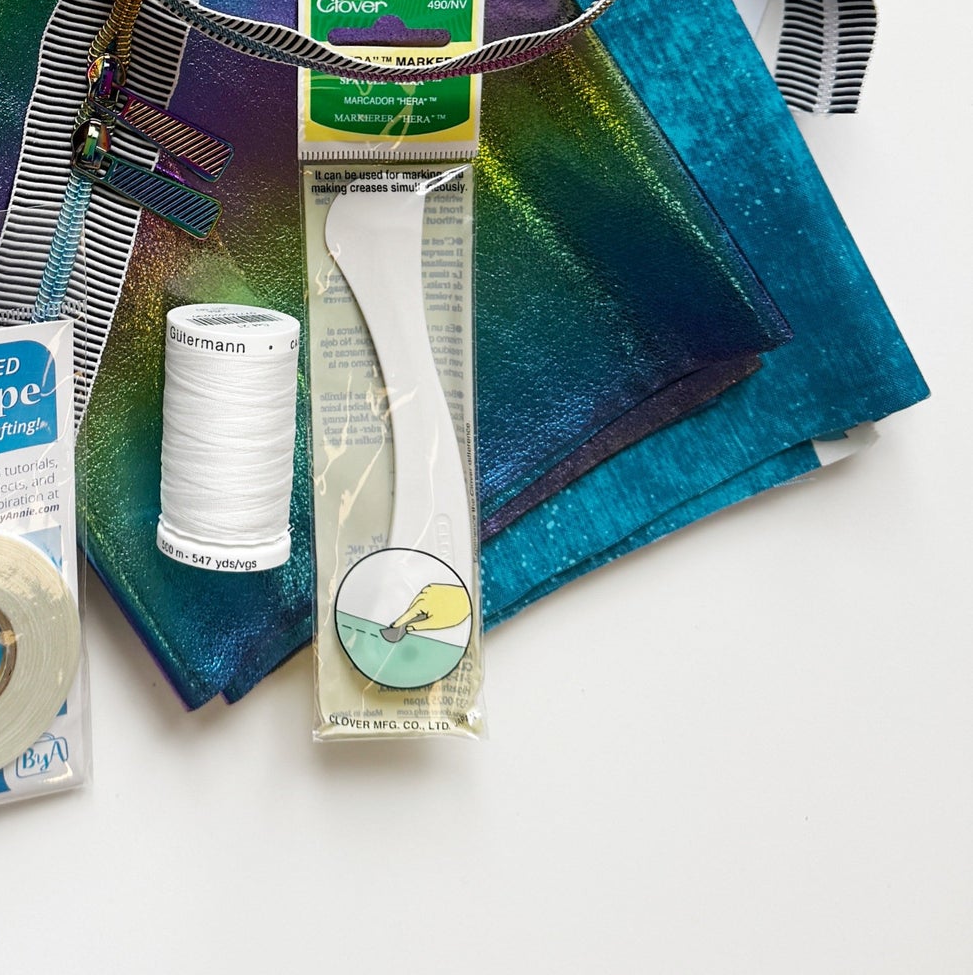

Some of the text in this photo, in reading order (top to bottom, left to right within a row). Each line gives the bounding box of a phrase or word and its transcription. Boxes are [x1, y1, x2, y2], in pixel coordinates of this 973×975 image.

[427, 0, 467, 9] 490/NV
[344, 97, 394, 105] MARCADOR
[315, 170, 321, 180] It
[324, 172, 342, 180] can
[344, 170, 357, 180] be
[360, 170, 383, 180] used
[386, 170, 399, 180] for
[311, 182, 347, 195] making
[350, 183, 388, 193] creases
[170, 326, 245, 353] Gütermann
[4, 457, 58, 477] tutorials,
[31, 472, 55, 487] and
[47, 489, 60, 501] at
[192, 554, 212, 566] 547
[215, 559, 257, 570] yds/vgs
[329, 715, 370, 729] CLOVER
[373, 721, 400, 730] MFG.
[403, 721, 425, 731] CO.,
[428, 721, 451, 731] LTD.
